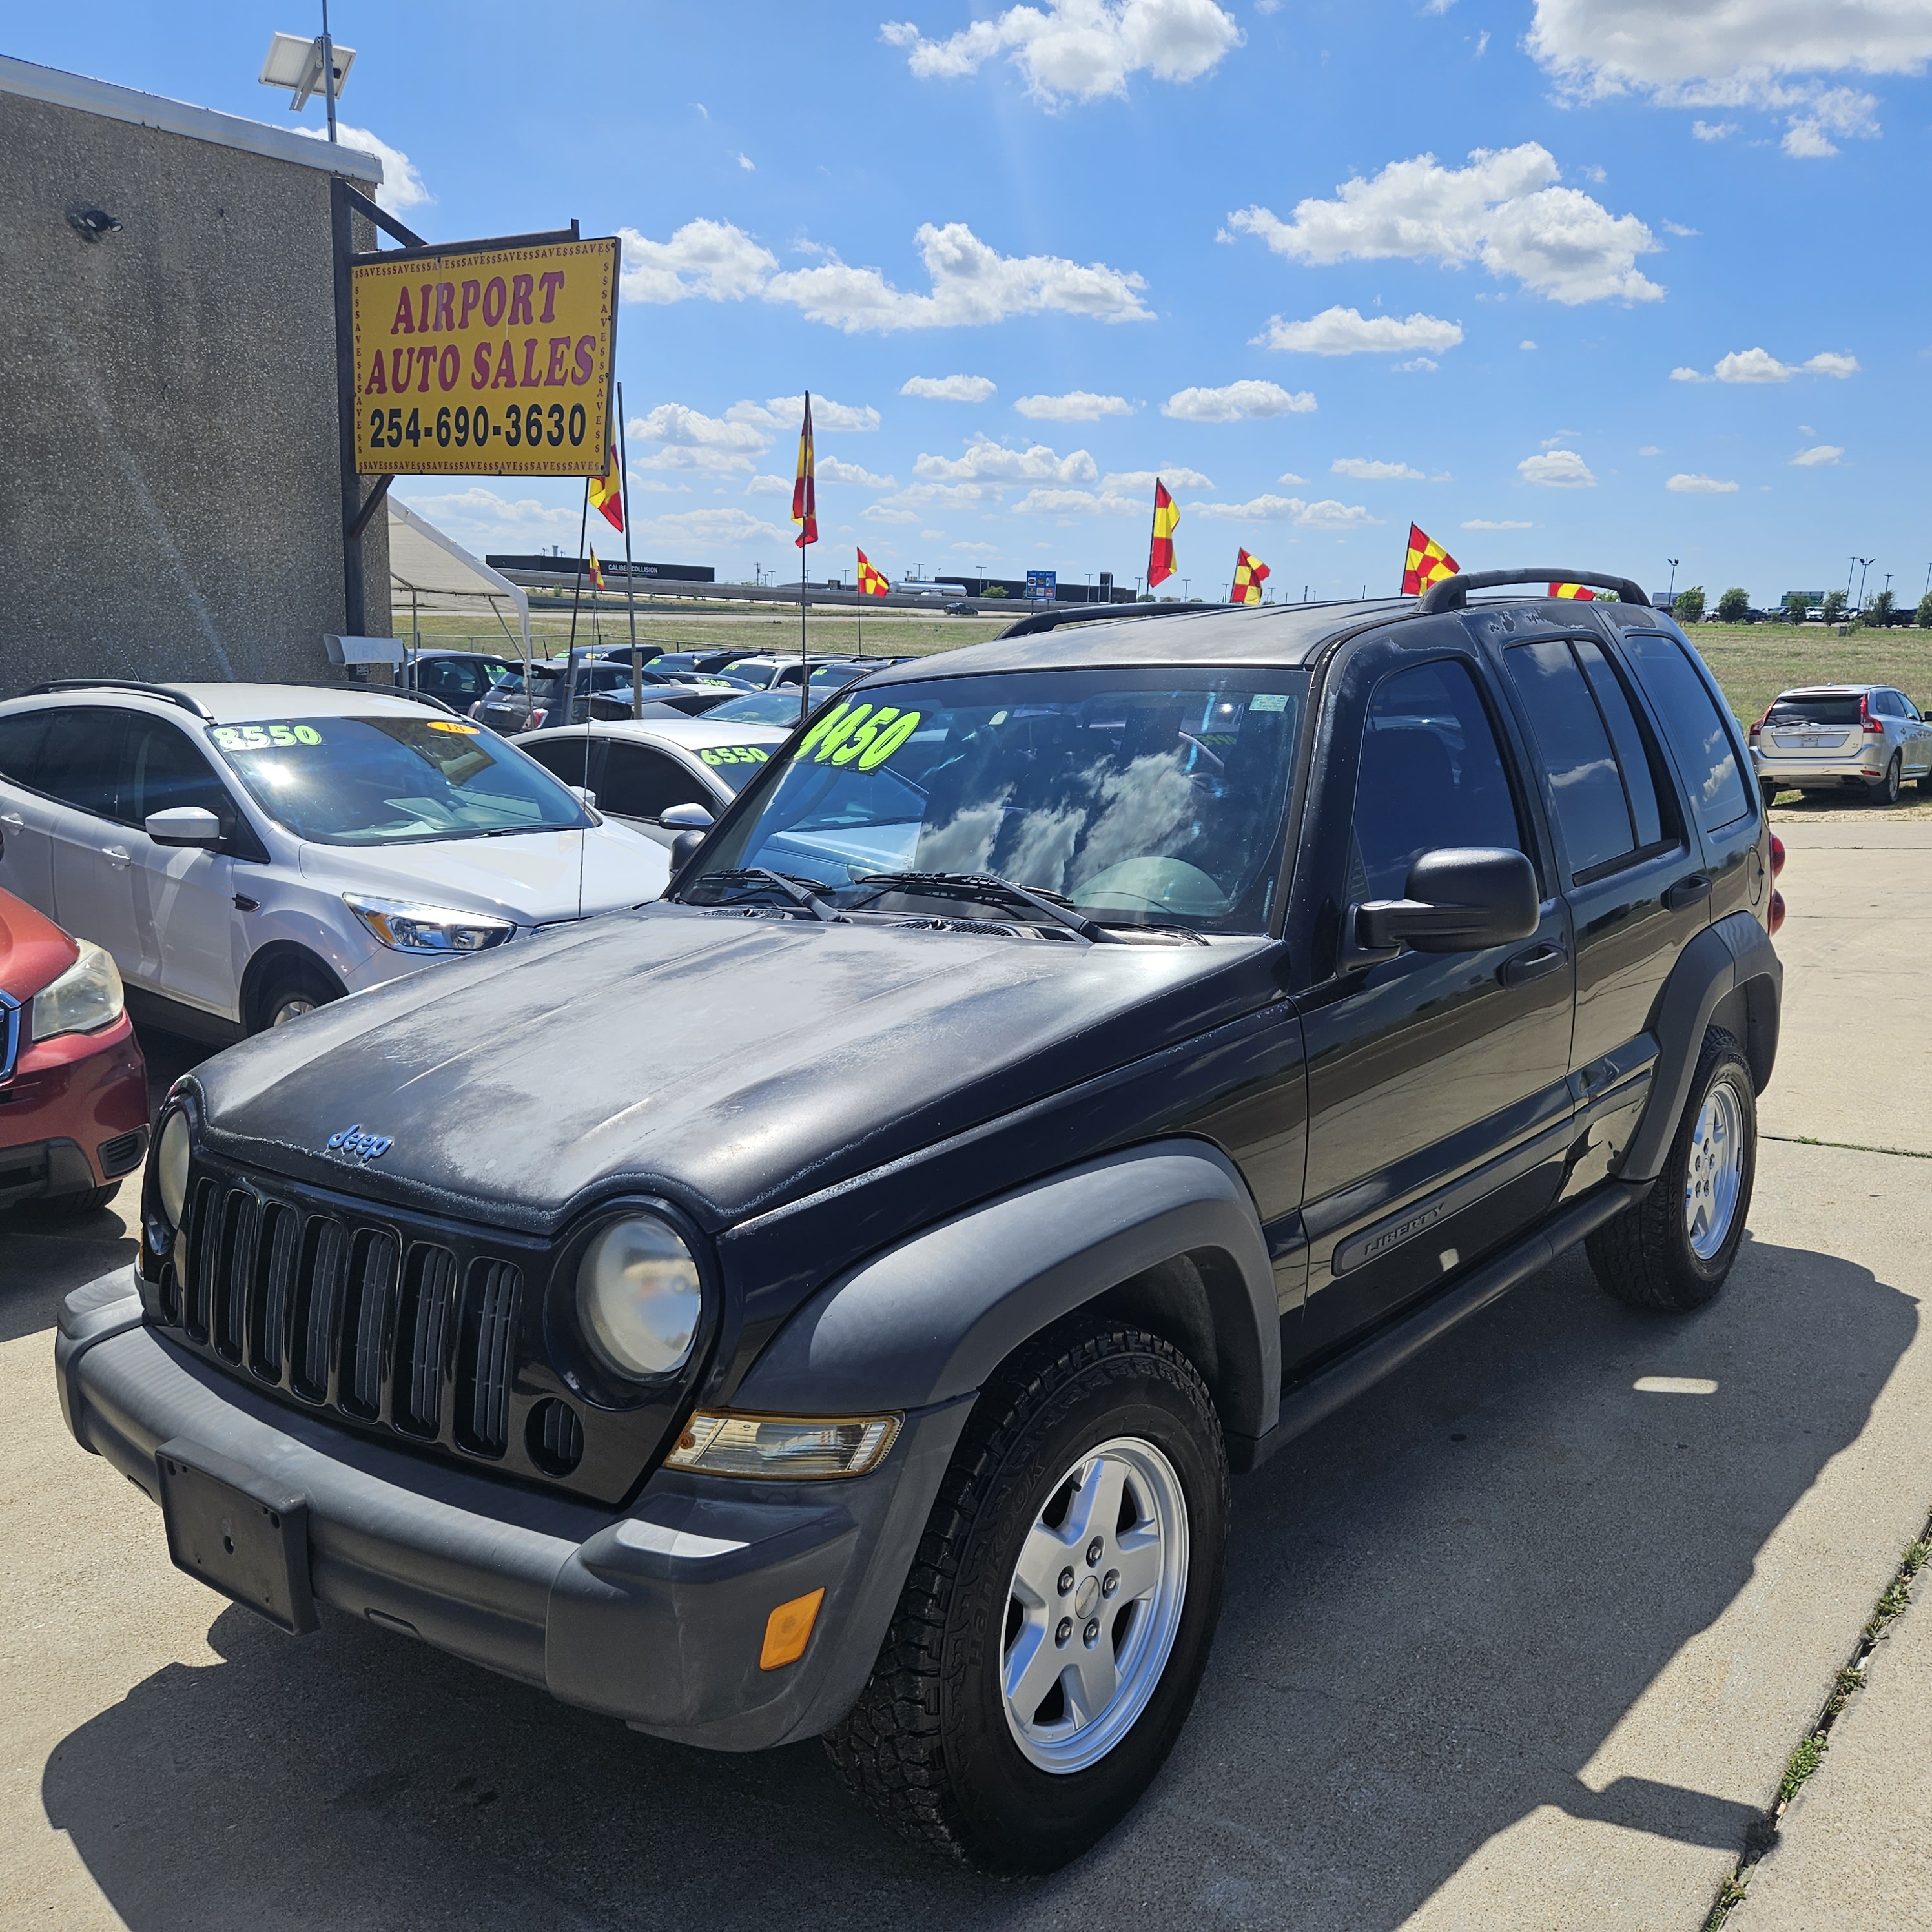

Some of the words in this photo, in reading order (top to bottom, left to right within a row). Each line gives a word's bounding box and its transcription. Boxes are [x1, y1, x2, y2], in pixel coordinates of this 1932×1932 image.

[391, 271, 564, 334] AIRPORT
[365, 344, 460, 395] AUTO
[471, 335, 596, 389] SALES
[370, 403, 586, 448] 254-690-3630
[631, 565, 658, 573] COLLISION
[213, 724, 322, 751] 8550
[701, 747, 770, 765] 6550
[793, 703, 921, 771] 4450
[328, 1124, 394, 1162] Jeep
[1364, 1202, 1445, 1257] LIBERTY
